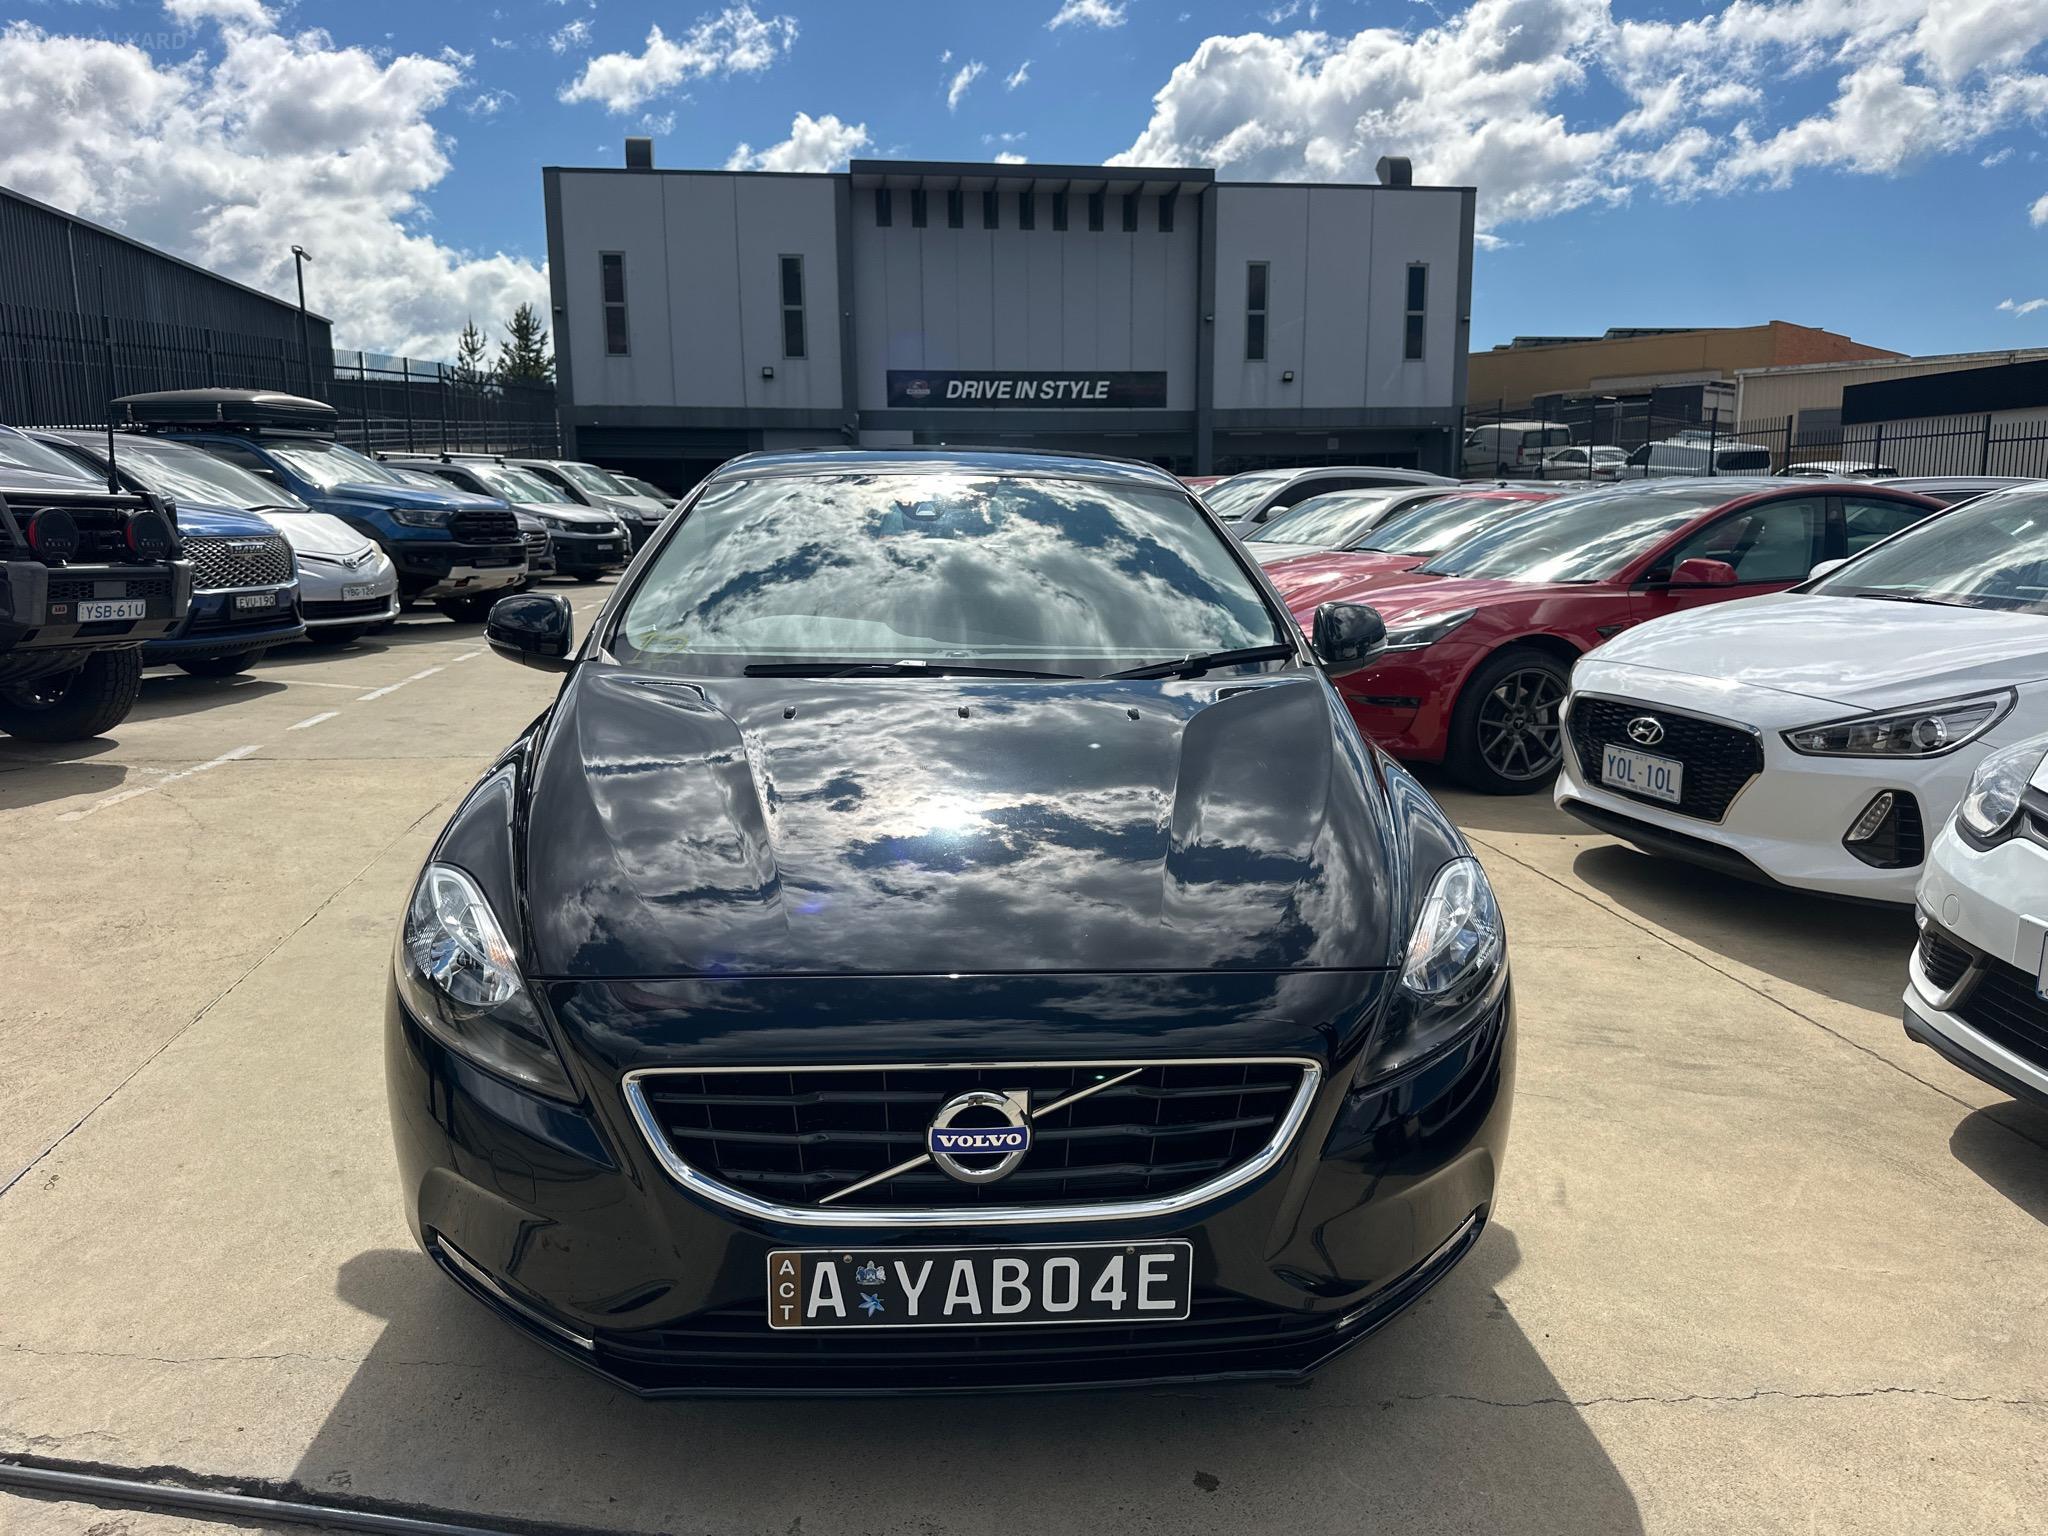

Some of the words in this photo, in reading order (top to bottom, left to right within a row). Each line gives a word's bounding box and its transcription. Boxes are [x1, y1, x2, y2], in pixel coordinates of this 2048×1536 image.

[946, 380, 1012, 399] DRIVE
[1015, 380, 1037, 399] IN
[1040, 380, 1110, 399] STYLE
[937, 1133, 1022, 1147] VOLVO
[779, 1259, 796, 1320] ACT
